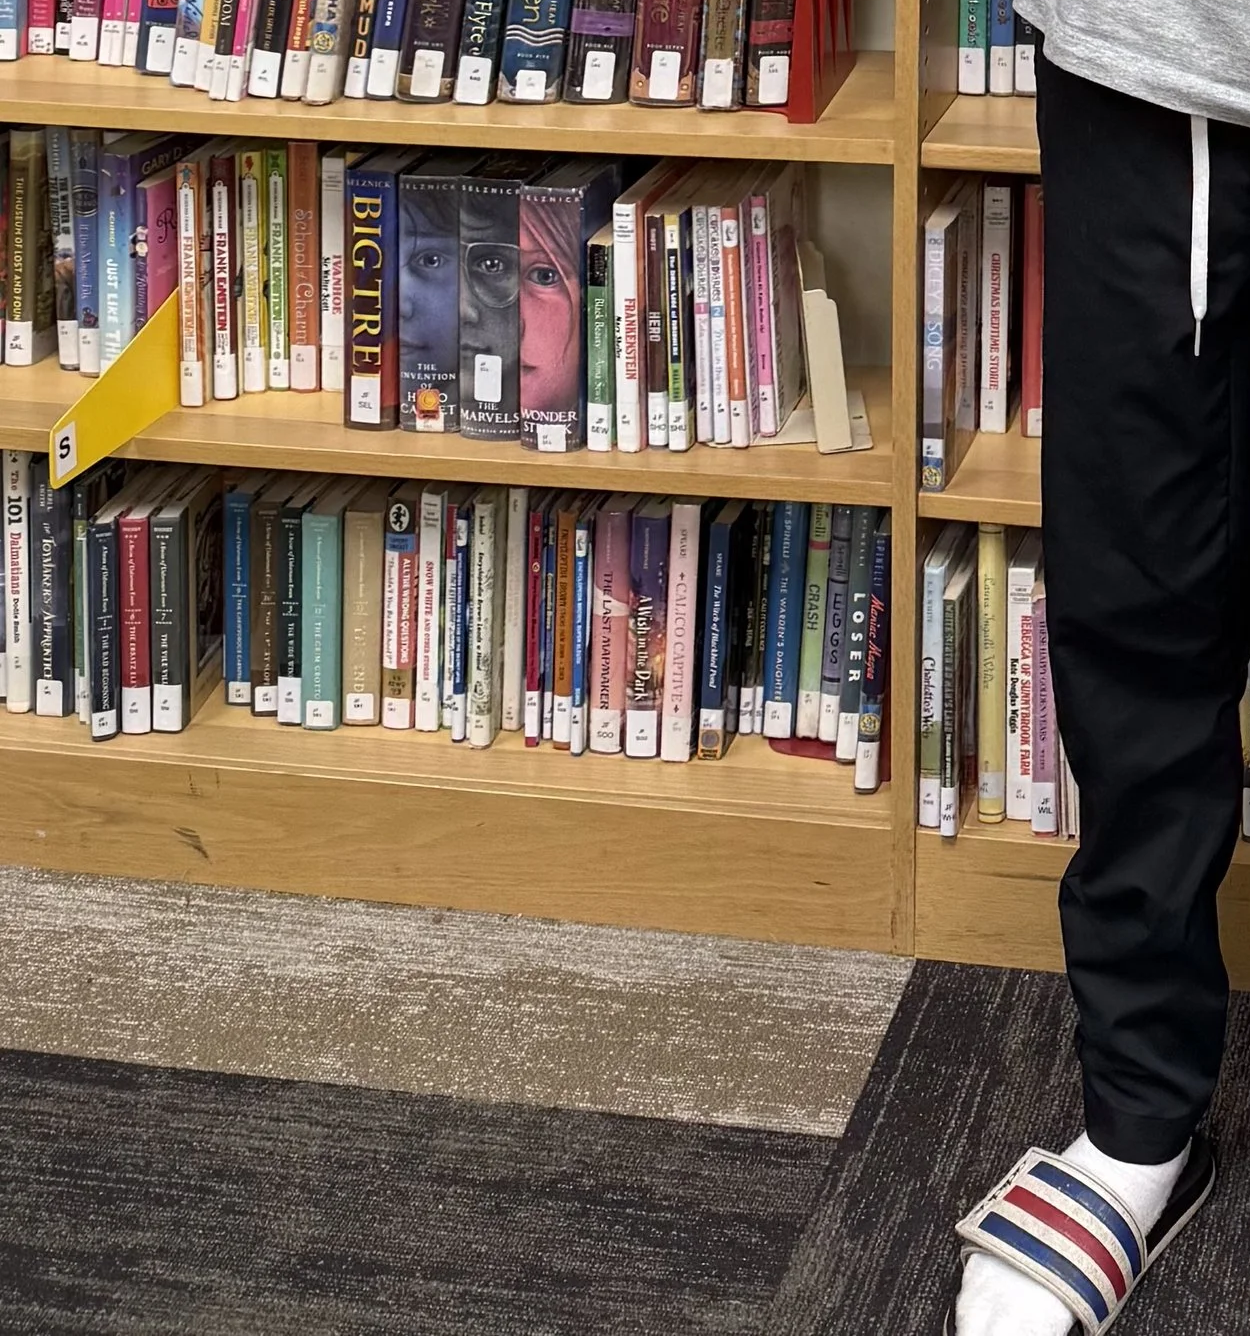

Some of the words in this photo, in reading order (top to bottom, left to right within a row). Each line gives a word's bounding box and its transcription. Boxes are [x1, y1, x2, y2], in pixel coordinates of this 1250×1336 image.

[468, 0, 493, 45] Flyte
[15, 177, 24, 198] THE
[14, 199, 24, 236] MUSEUM
[352, 193, 383, 269] BIG
[215, 232, 228, 275] FRANK
[271, 222, 282, 265] FRANK
[294, 208, 313, 272] School
[13, 249, 23, 277] LOST
[106, 258, 119, 290] JUST
[183, 236, 194, 279] FRANK
[13, 278, 23, 300] AND
[331, 254, 343, 315] IVANHOE
[990, 253, 1001, 308] CHRISTMAS
[106, 293, 119, 324] LIKE
[713, 306, 722, 316] 2
[623, 297, 638, 381] FRANKENSTEIN
[649, 311, 662, 343] HERO
[989, 309, 1000, 349] BEDTIME
[927, 320, 943, 371] SONG
[401, 371, 456, 381] INVENTION
[417, 363, 437, 371] THE
[358, 401, 373, 410] SEL
[460, 408, 520, 424] MARVELS
[478, 401, 499, 411] THE
[521, 408, 578, 423] WONDER
[58, 435, 71, 460] S
[7, 495, 23, 526] 101
[782, 517, 792, 559] SPINELLI
[10, 533, 22, 595] Dalmatians
[425, 560, 434, 585] SNOW
[424, 586, 433, 617] WHITE
[604, 572, 614, 597] THE
[780, 576, 789, 594] THE
[603, 598, 613, 631] LAST
[638, 608, 652, 637] Wish
[675, 582, 687, 638] CALICO
[777, 596, 788, 647] WARDEN'S
[807, 584, 821, 631] CRASH
[829, 593, 842, 664] EGGS
[848, 592, 866, 683] LOSER
[1019, 615, 1032, 661] REBECCA
[601, 634, 611, 710] MAPMAKER
[633, 667, 650, 702] Dark
[671, 640, 685, 703] CAPTIVE
[1020, 662, 1031, 675] OF
[1019, 677, 1032, 747] SUNNYBROOK
[596, 730, 614, 739] SOO
[1018, 748, 1031, 776] FARM
